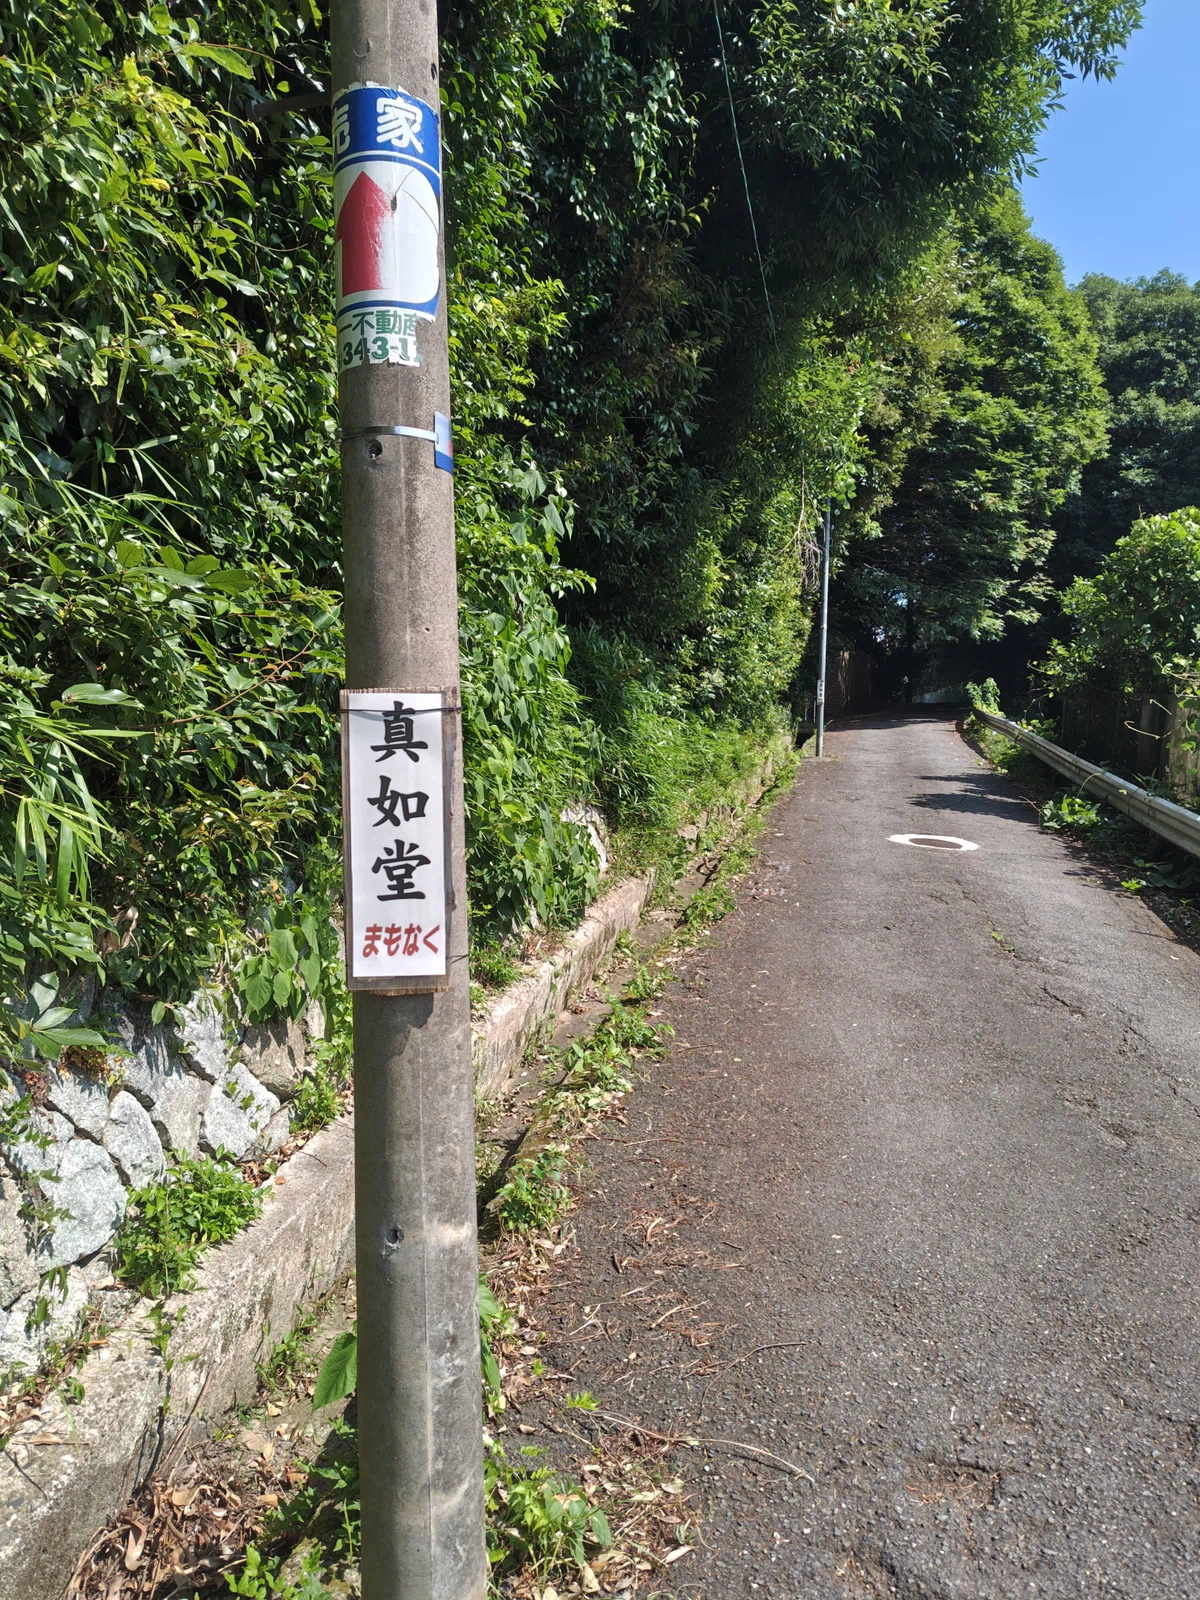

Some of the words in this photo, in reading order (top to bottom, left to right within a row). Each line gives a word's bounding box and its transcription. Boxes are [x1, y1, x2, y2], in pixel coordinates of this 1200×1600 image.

[367, 700, 431, 902] 真如堂
[362, 922, 441, 958] まもなく
